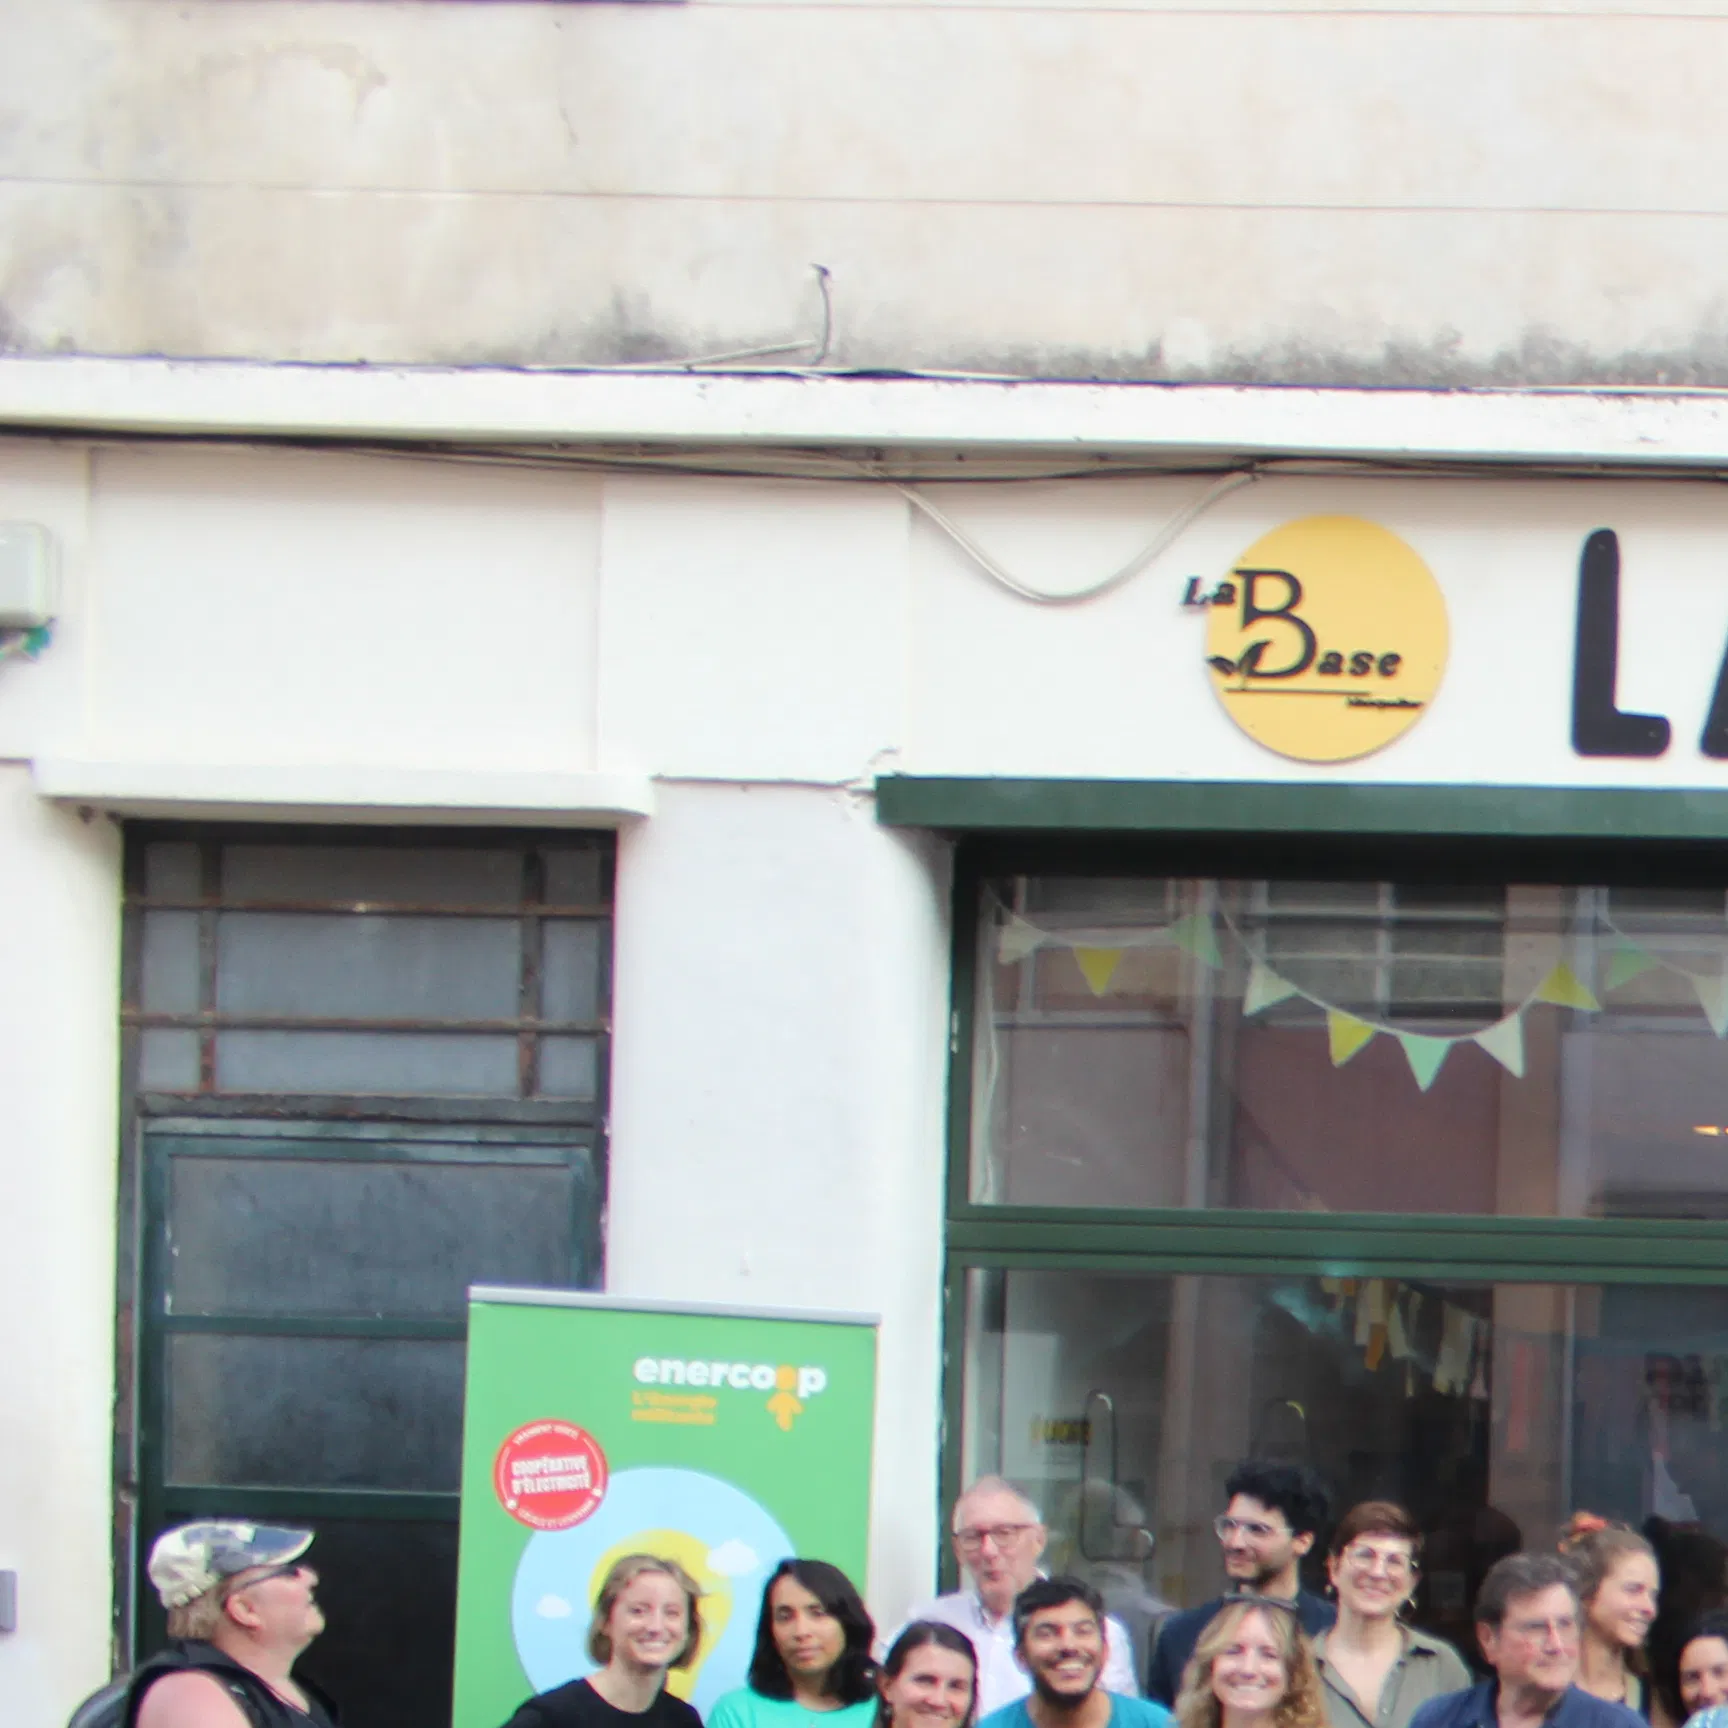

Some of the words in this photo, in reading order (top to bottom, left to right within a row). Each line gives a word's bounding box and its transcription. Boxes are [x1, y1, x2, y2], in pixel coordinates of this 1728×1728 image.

[1181, 575, 1236, 606] La
[1232, 567, 1402, 681] Base
[633, 1356, 828, 1399] enercoop
